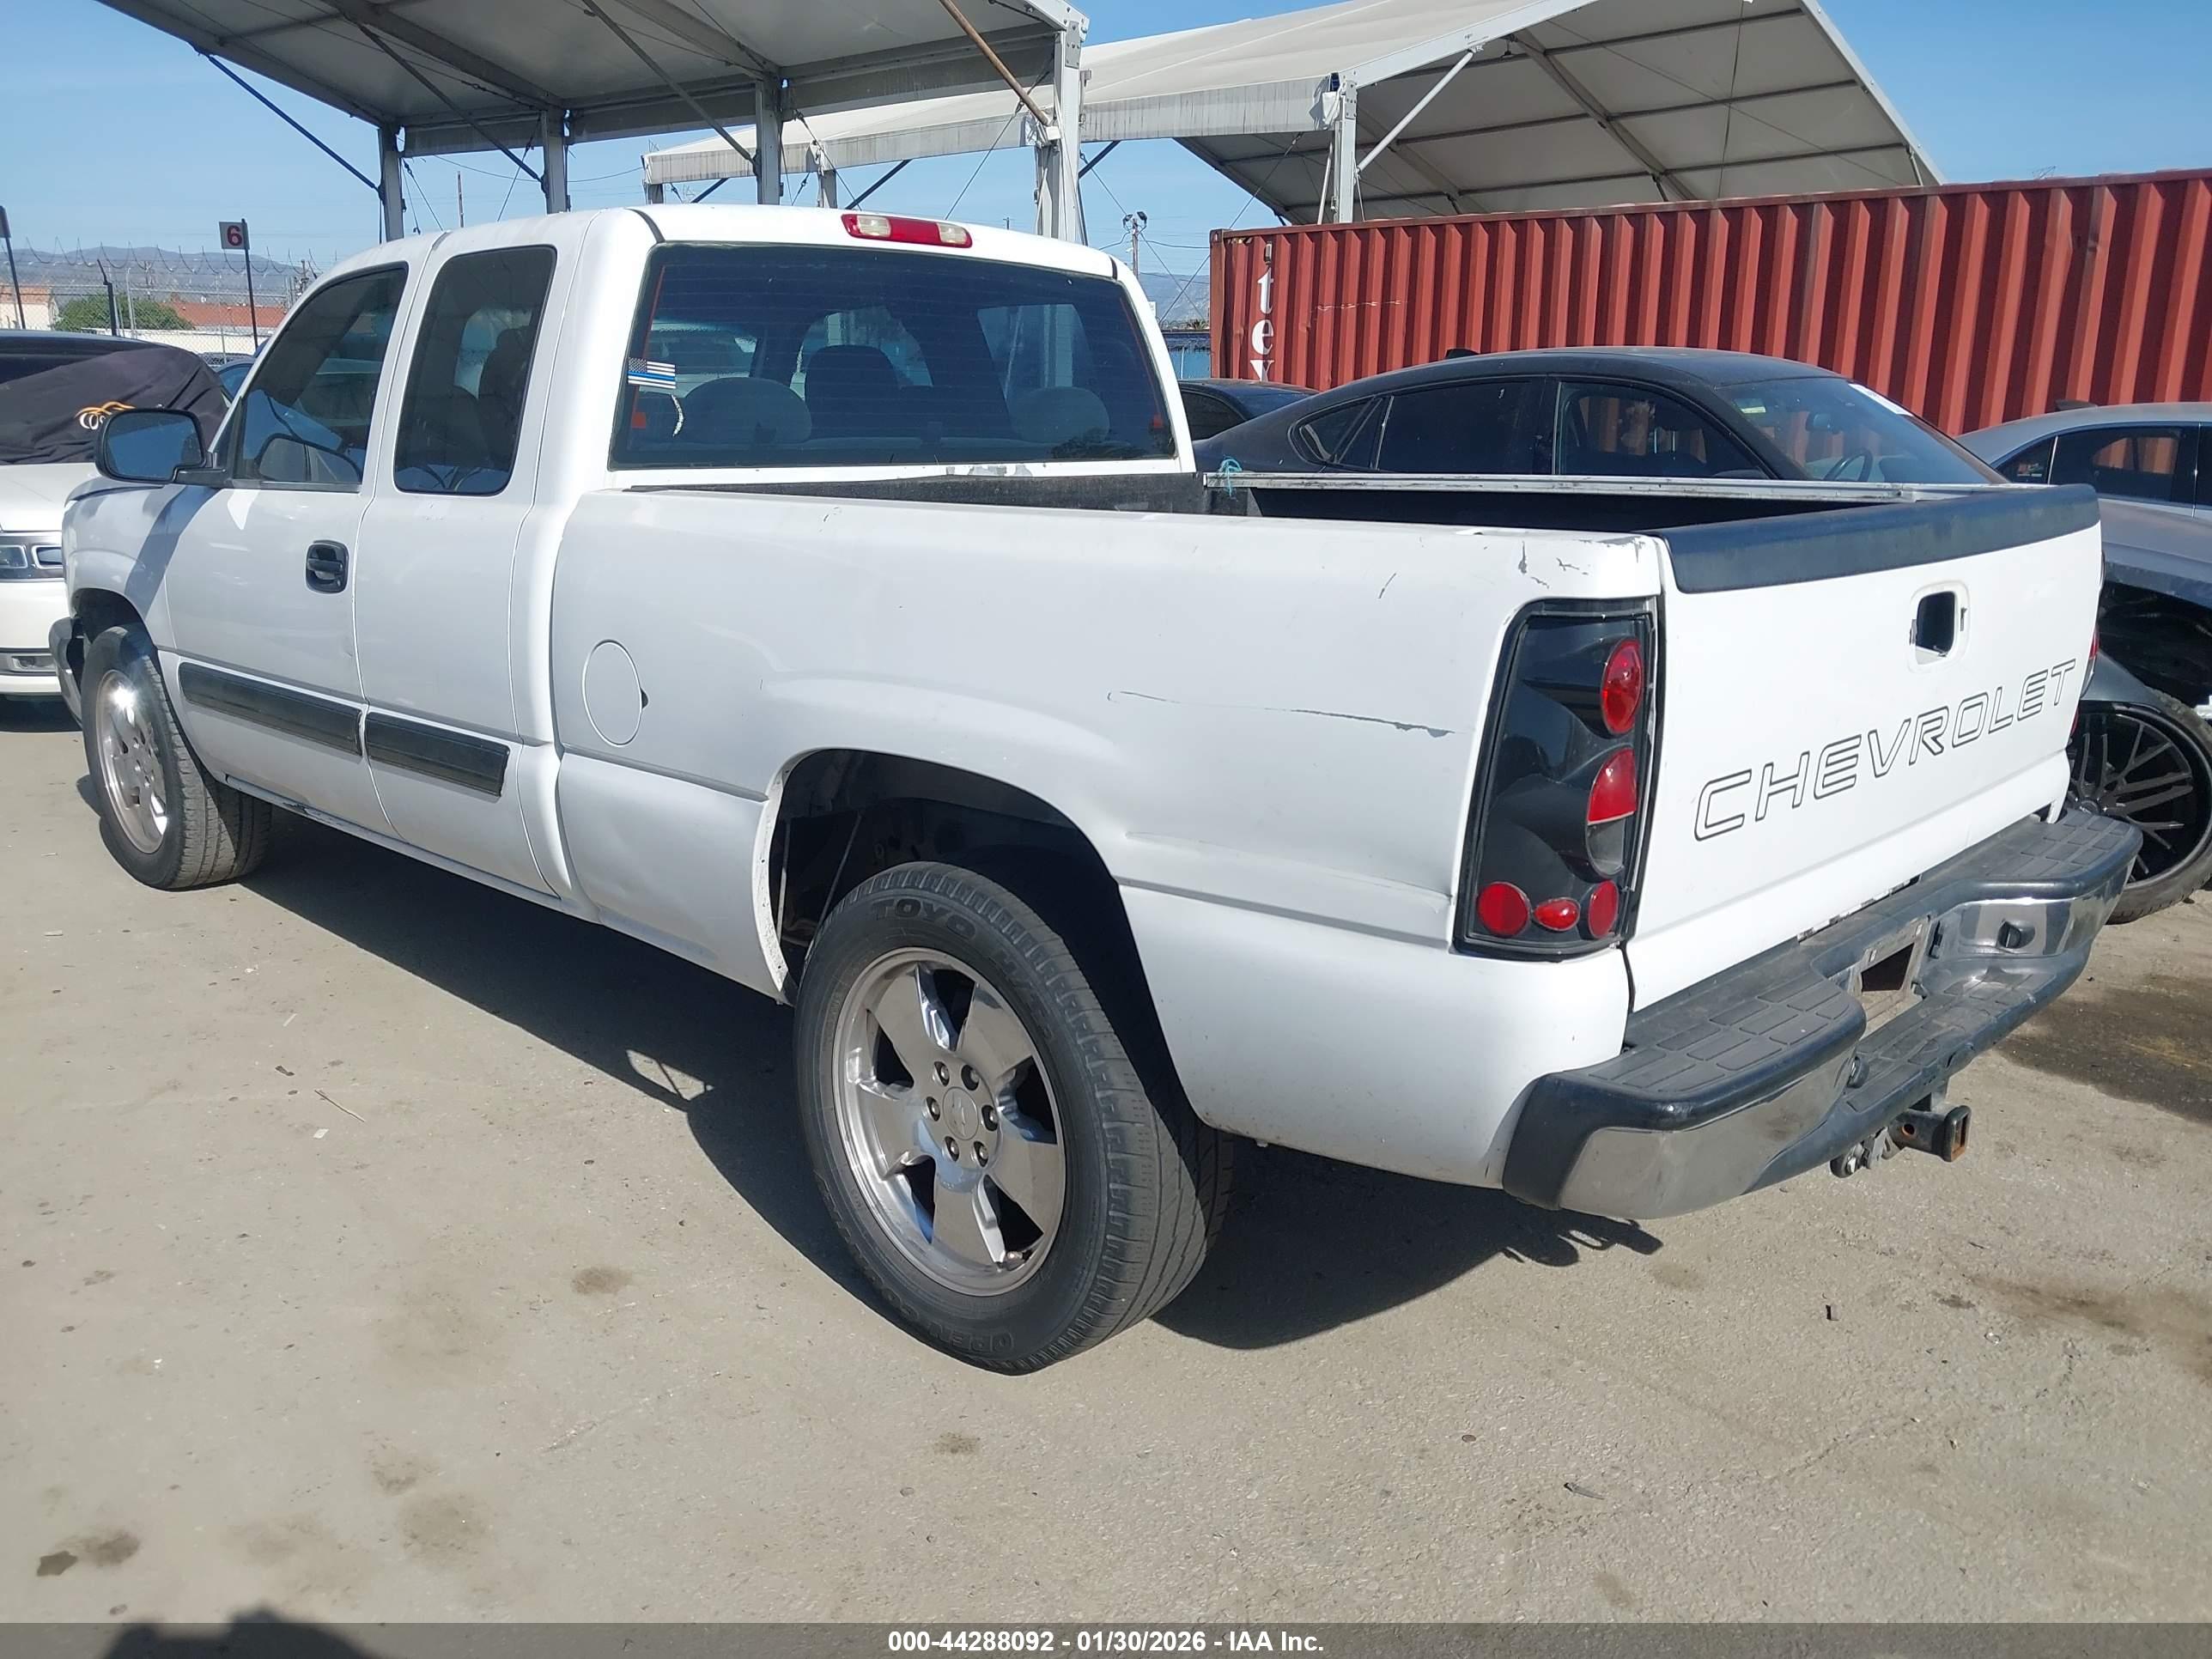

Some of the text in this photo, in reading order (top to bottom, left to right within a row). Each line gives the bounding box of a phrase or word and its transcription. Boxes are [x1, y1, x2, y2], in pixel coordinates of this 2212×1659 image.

[227, 225, 243, 246] 6
[1694, 659, 2075, 842] CHEVROLET
[870, 897, 977, 940] TOYO
